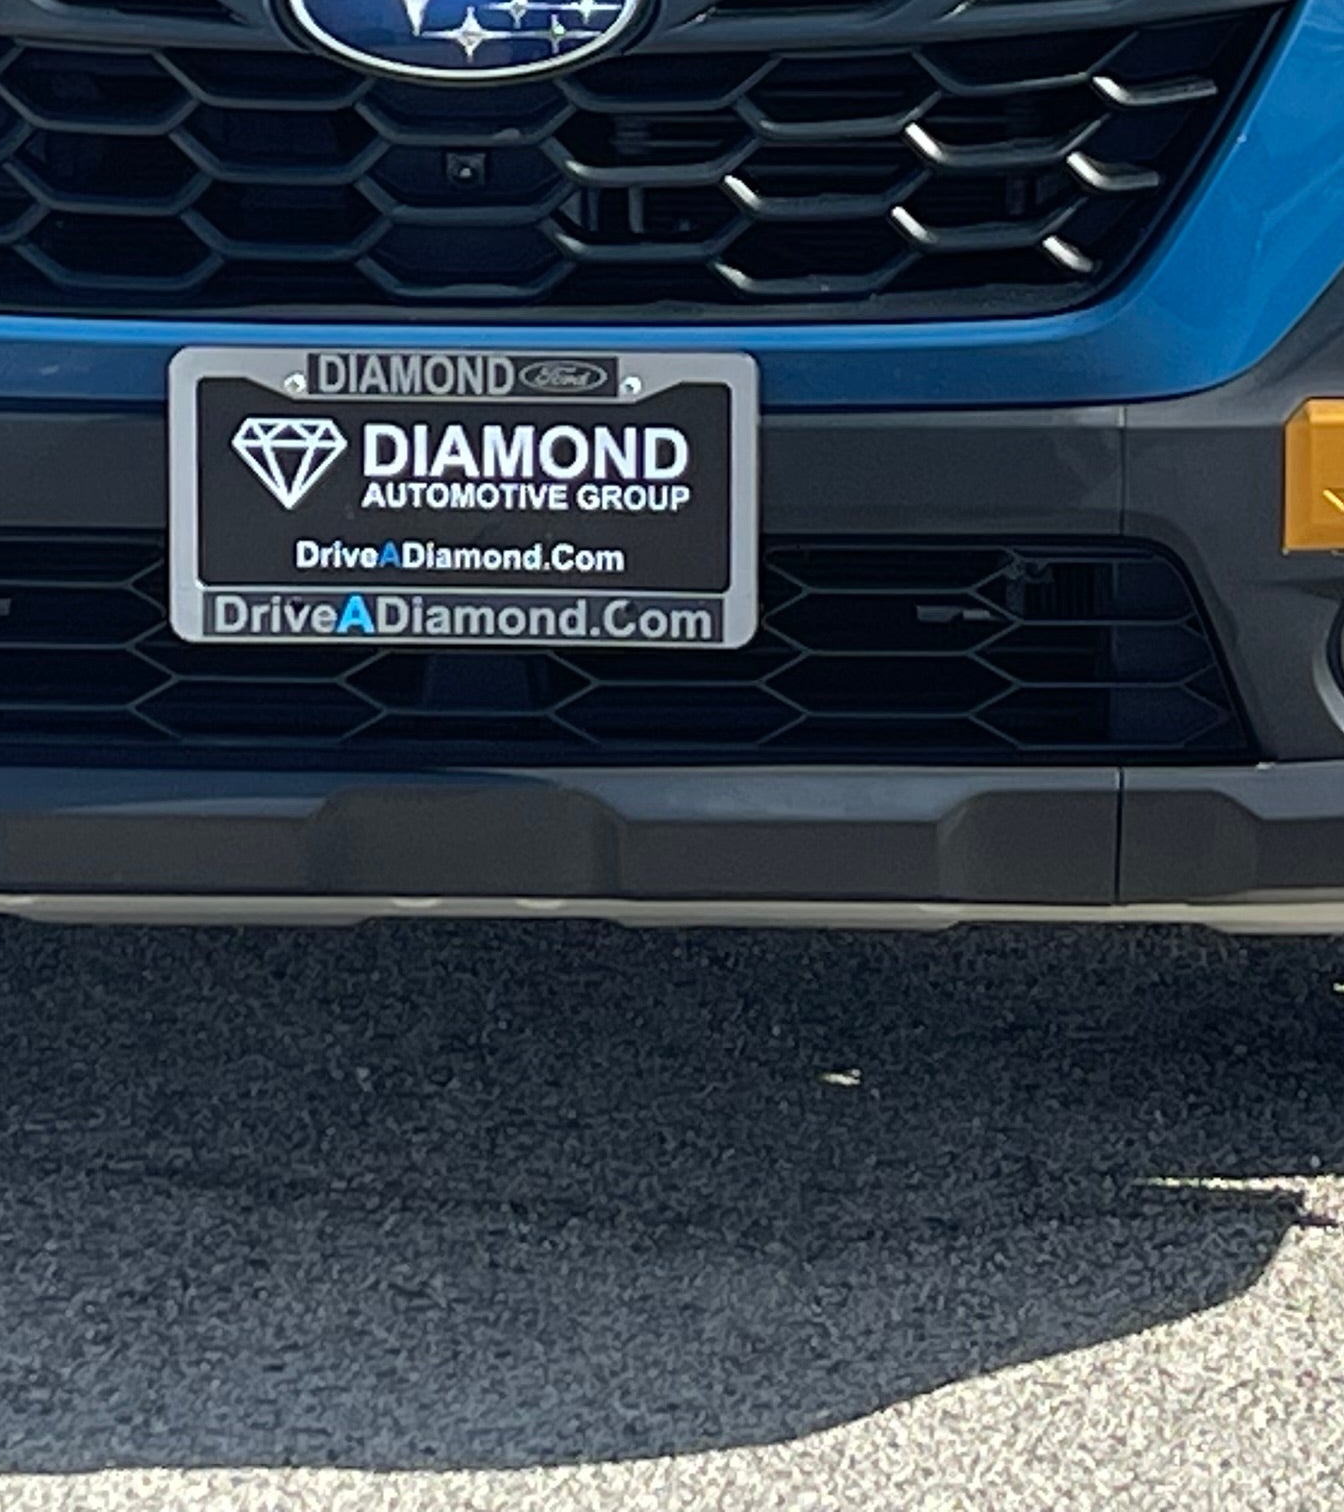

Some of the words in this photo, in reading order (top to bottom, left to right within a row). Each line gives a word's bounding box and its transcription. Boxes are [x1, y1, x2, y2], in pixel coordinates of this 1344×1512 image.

[319, 354, 515, 395] DIAMOND
[534, 365, 592, 387] Ford
[362, 424, 689, 479] DIAMOND
[362, 483, 568, 509] AUTOMOTIVE
[577, 484, 690, 512] GROUP
[297, 540, 624, 572] DriveADiamond.Com
[213, 595, 712, 639] DriveADiamond.Com
